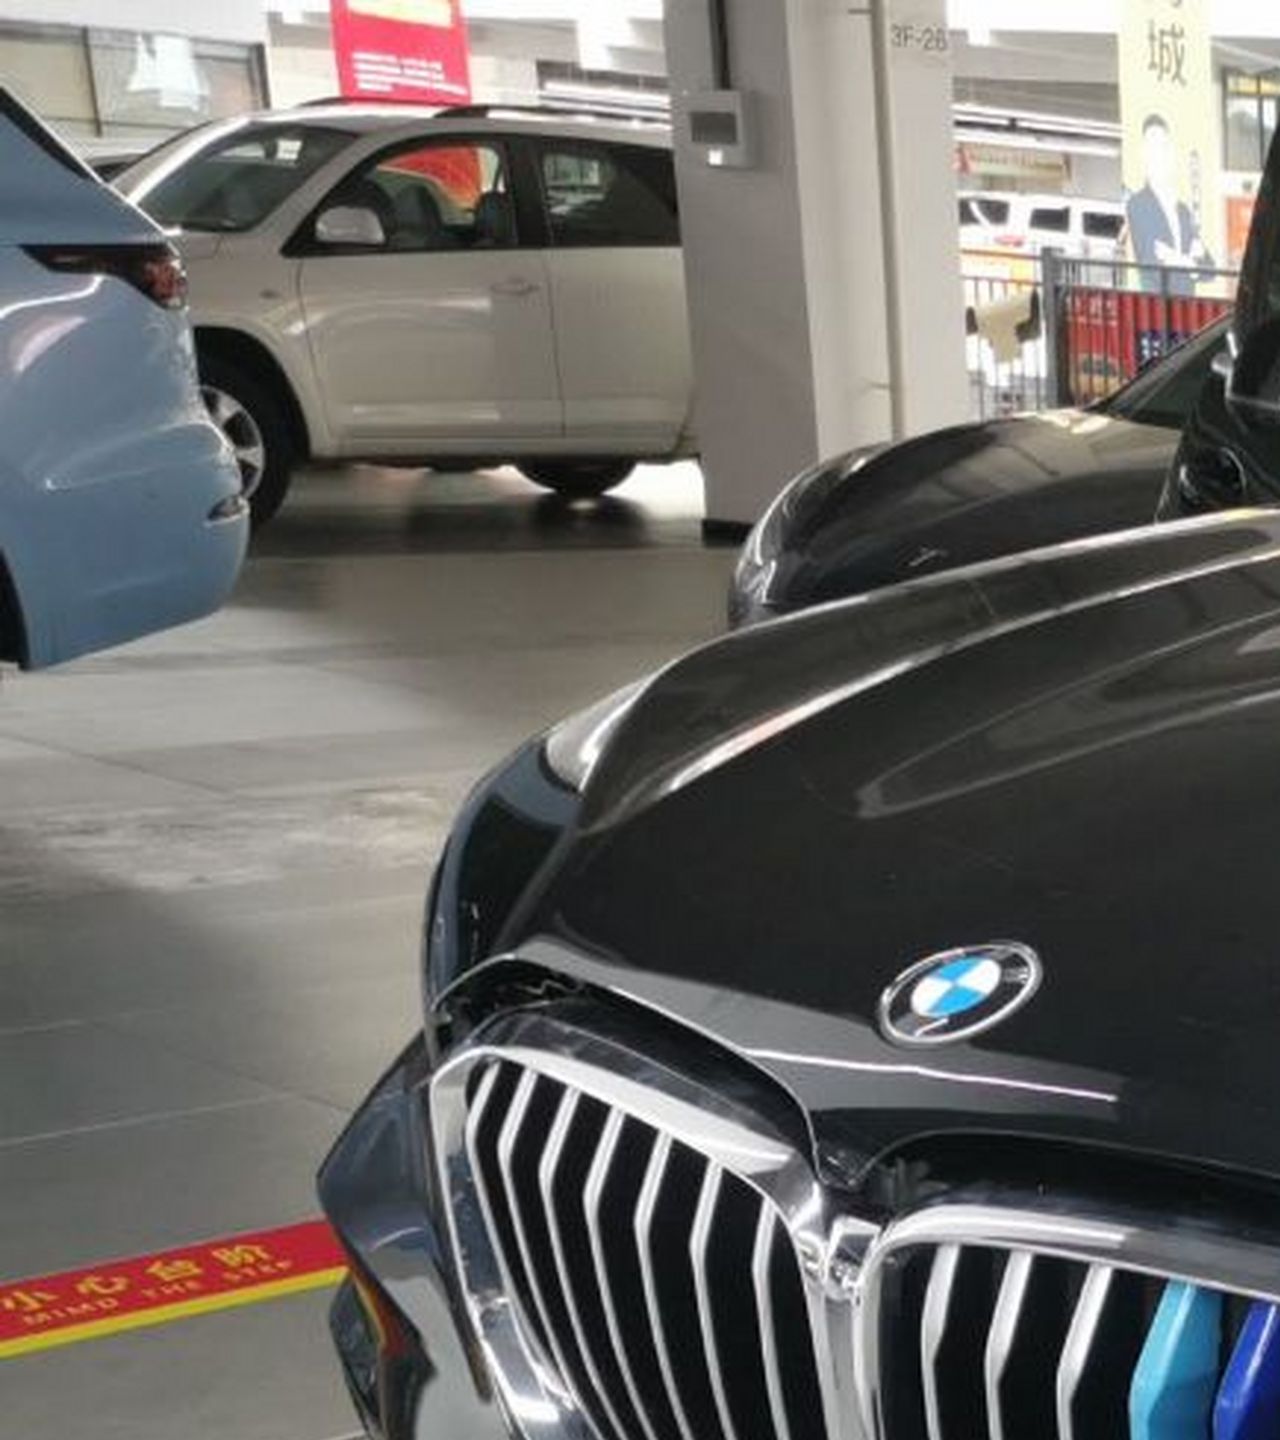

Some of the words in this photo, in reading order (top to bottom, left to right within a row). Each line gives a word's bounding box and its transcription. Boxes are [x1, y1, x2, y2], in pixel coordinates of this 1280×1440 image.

[1146, 0, 1188, 87] 城
[2, 1244, 271, 1312] 小心台阶
[142, 1279, 203, 1298] THE
